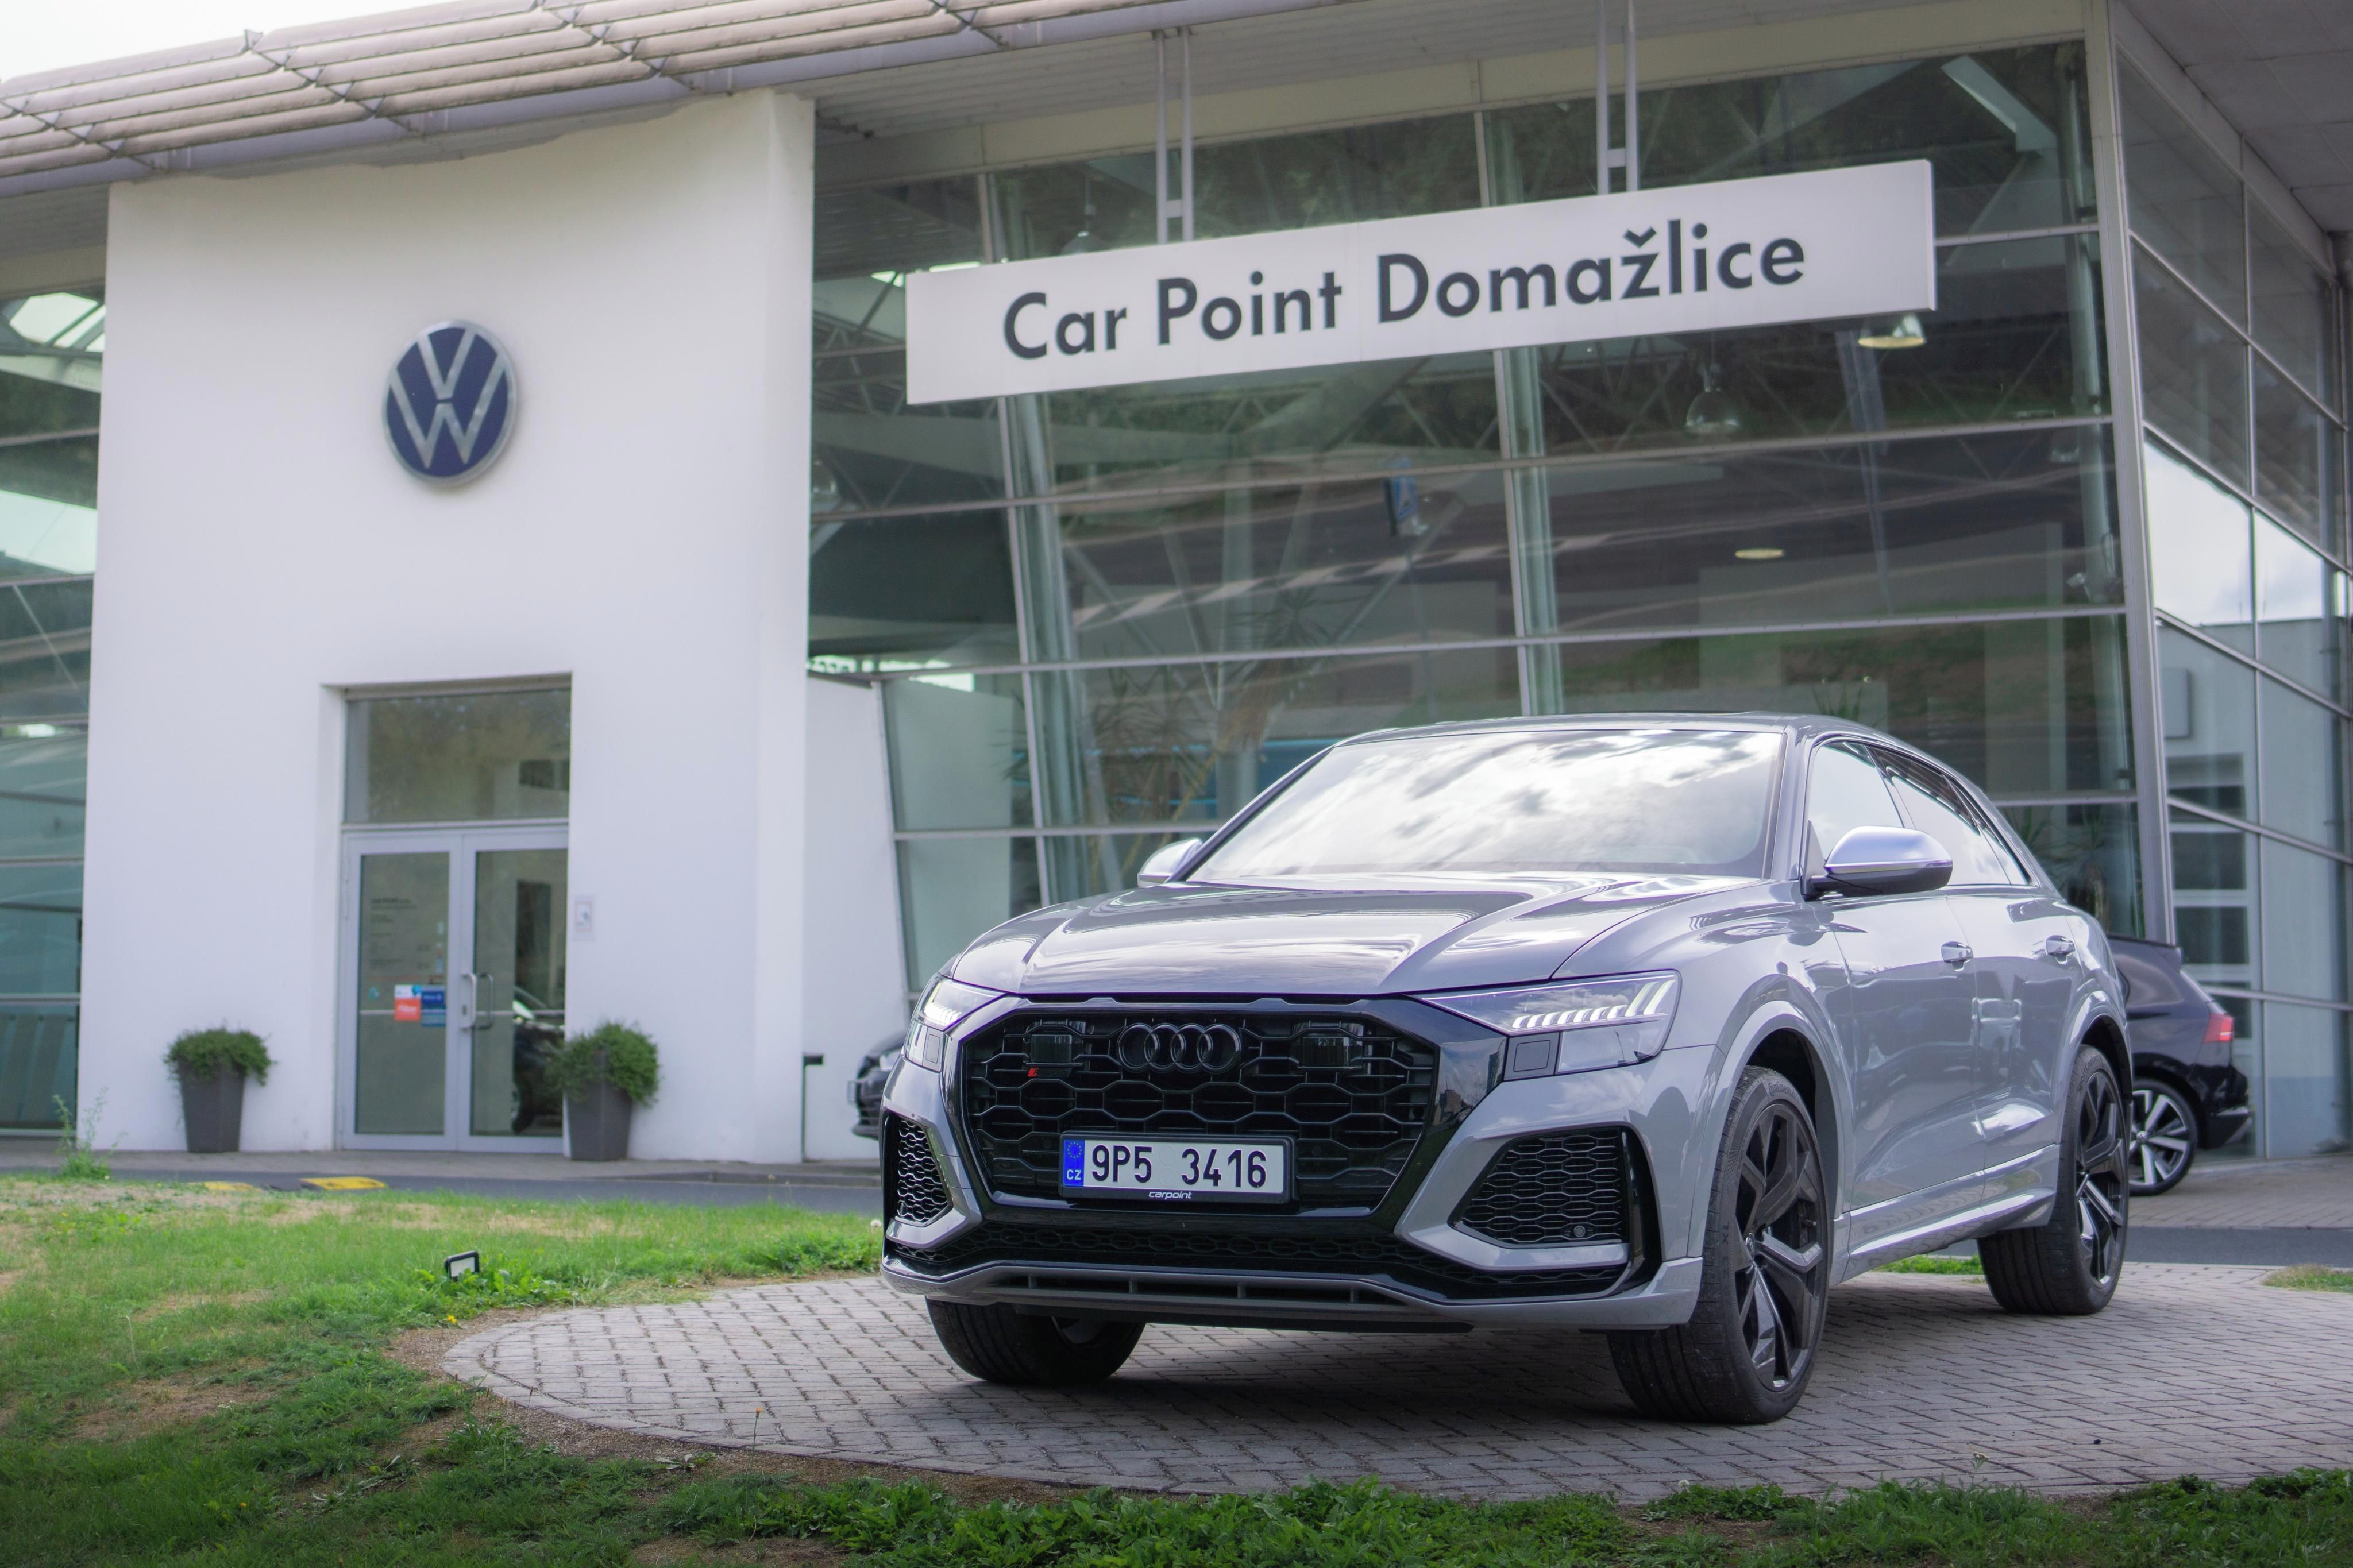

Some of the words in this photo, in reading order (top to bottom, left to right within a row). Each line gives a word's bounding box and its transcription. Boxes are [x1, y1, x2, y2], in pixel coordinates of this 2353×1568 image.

[1005, 292, 1127, 360] Car
[1158, 271, 1342, 345] Point
[1378, 219, 1804, 323] Domažlice
[384, 323, 512, 472] VW
[1066, 1169, 1081, 1180] CZ
[1091, 1144, 1152, 1183] 9P5
[1181, 1148, 1267, 1188] 3416
[1148, 1191, 1193, 1200] carpoint
